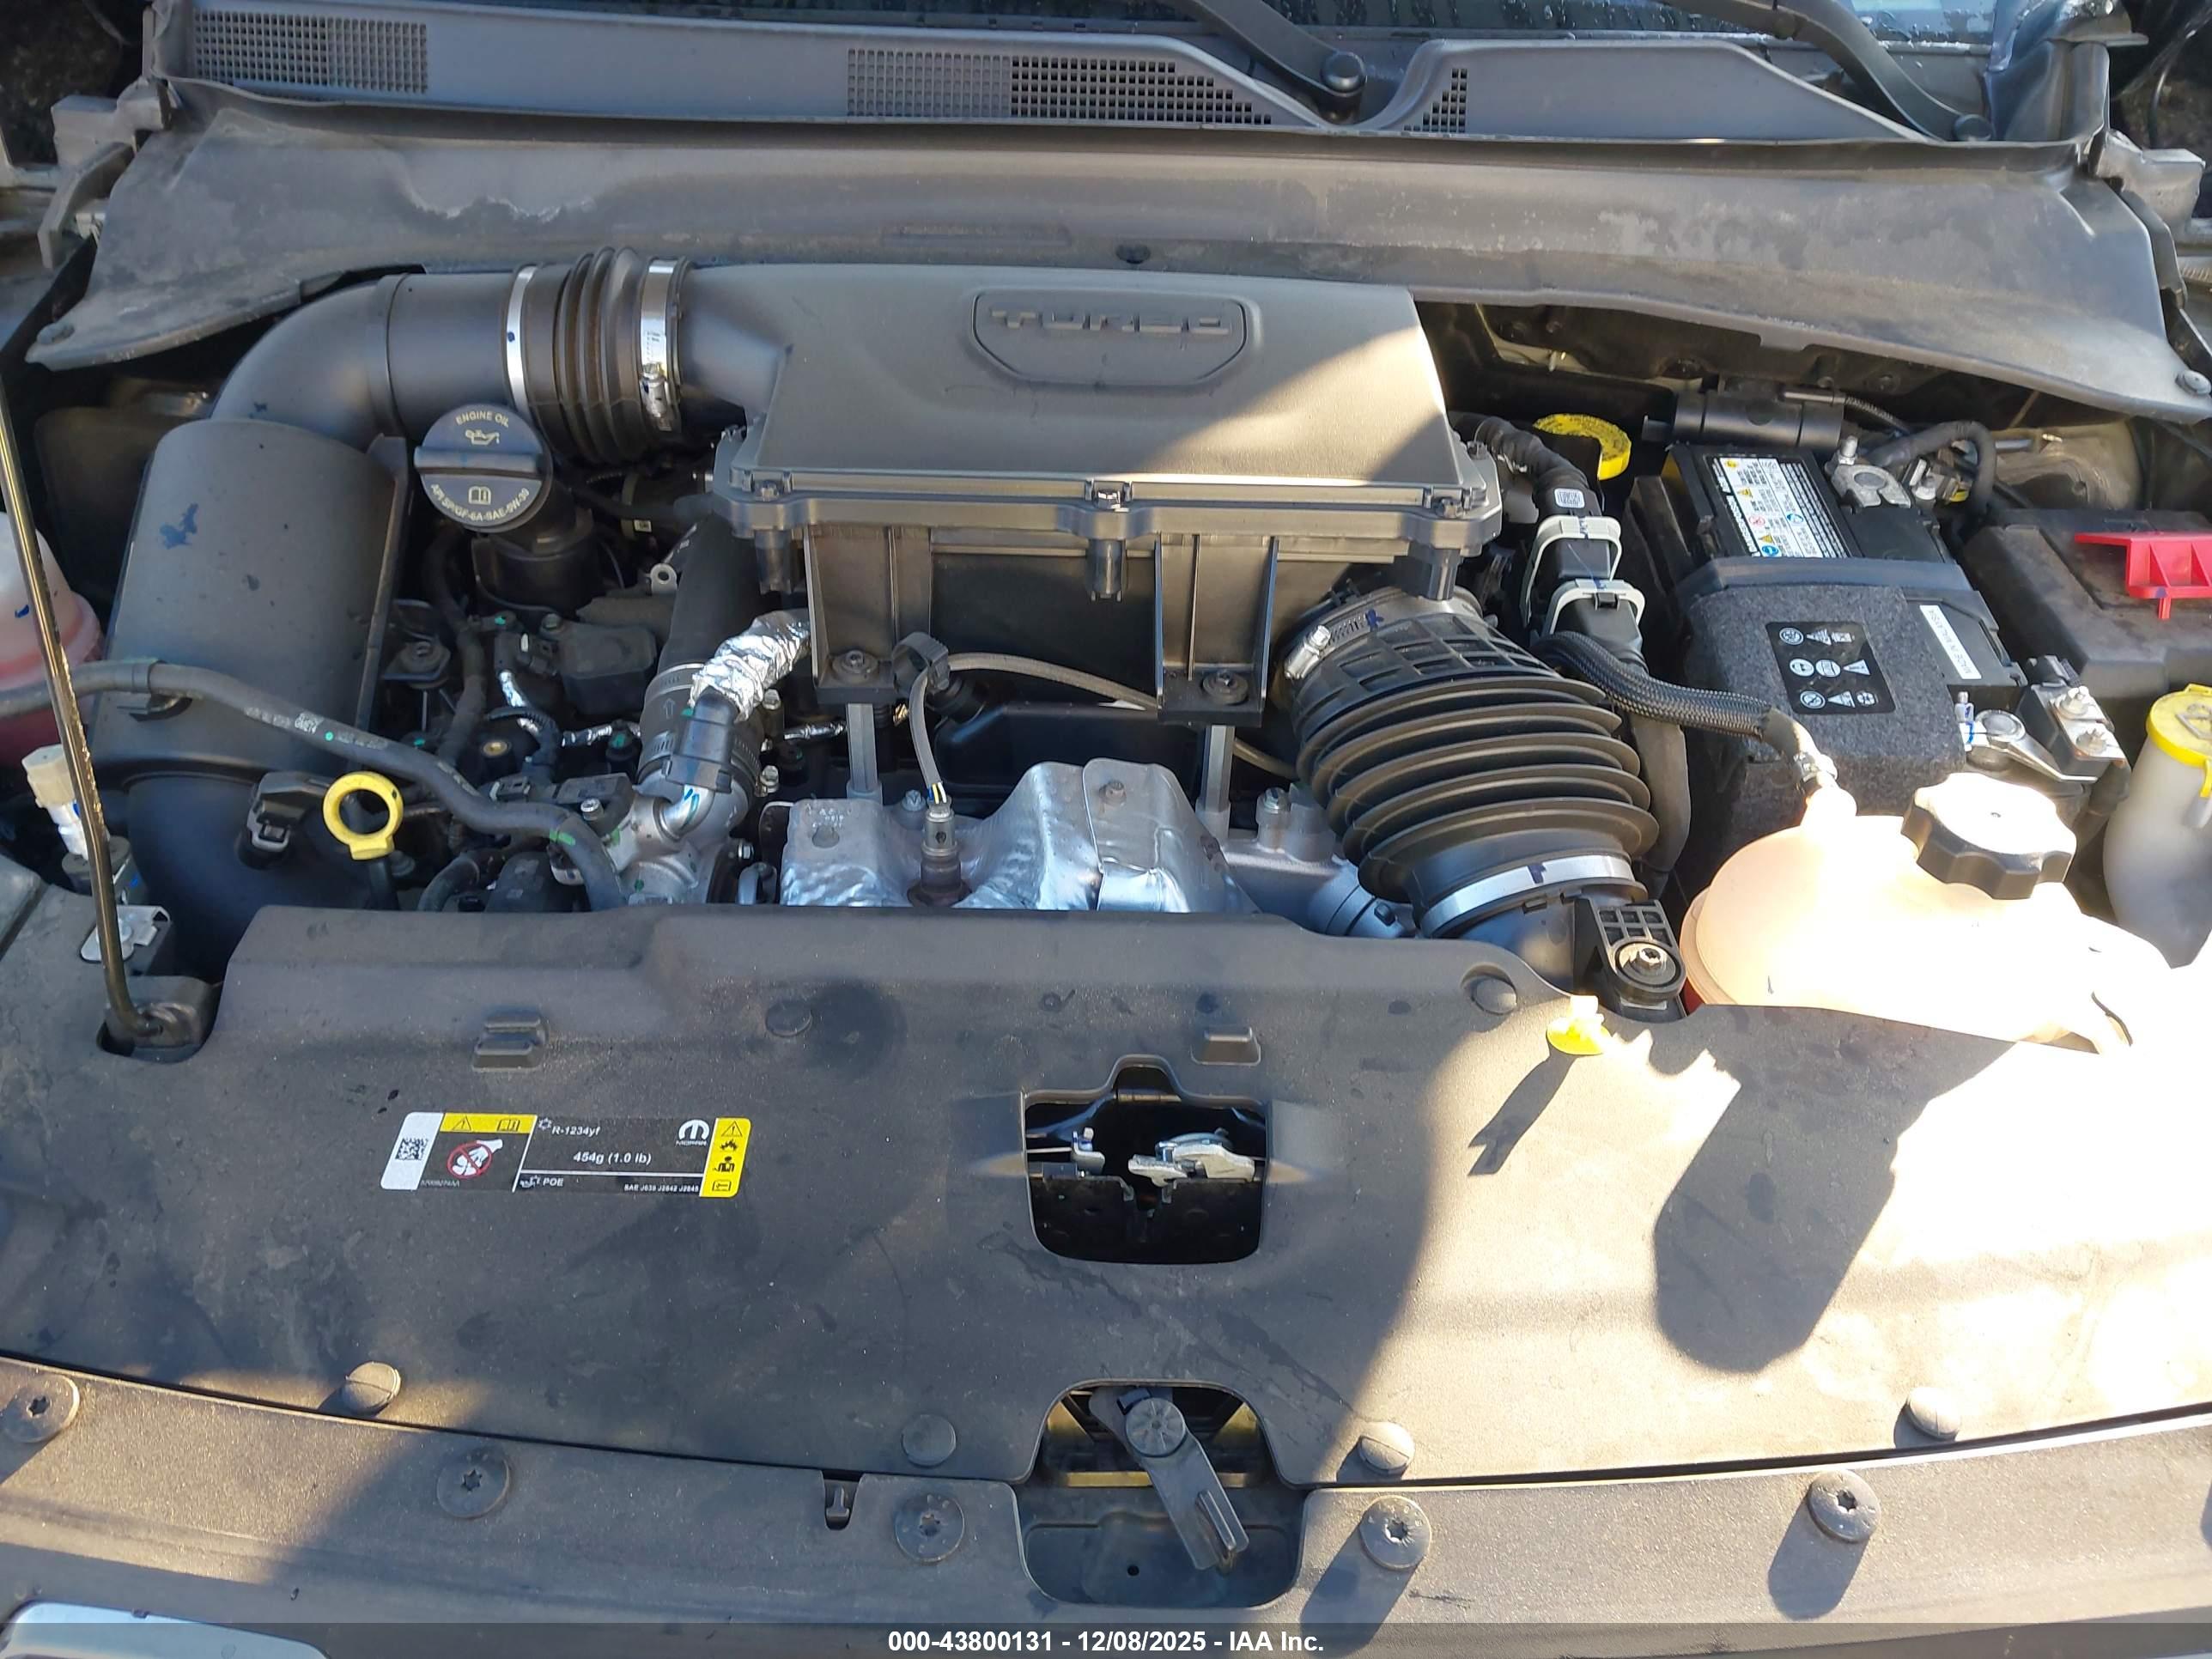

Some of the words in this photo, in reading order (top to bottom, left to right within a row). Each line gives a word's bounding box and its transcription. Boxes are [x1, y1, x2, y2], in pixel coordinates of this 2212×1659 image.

[990, 308, 1230, 335] TURBO
[455, 410, 493, 425] ENGINE
[495, 414, 509, 428] OIL
[551, 1126, 601, 1138] R-1234yf
[573, 1151, 605, 1165] 454g
[608, 1152, 632, 1165] (1.0
[635, 1152, 652, 1166] lb)
[543, 1177, 564, 1187] POE
